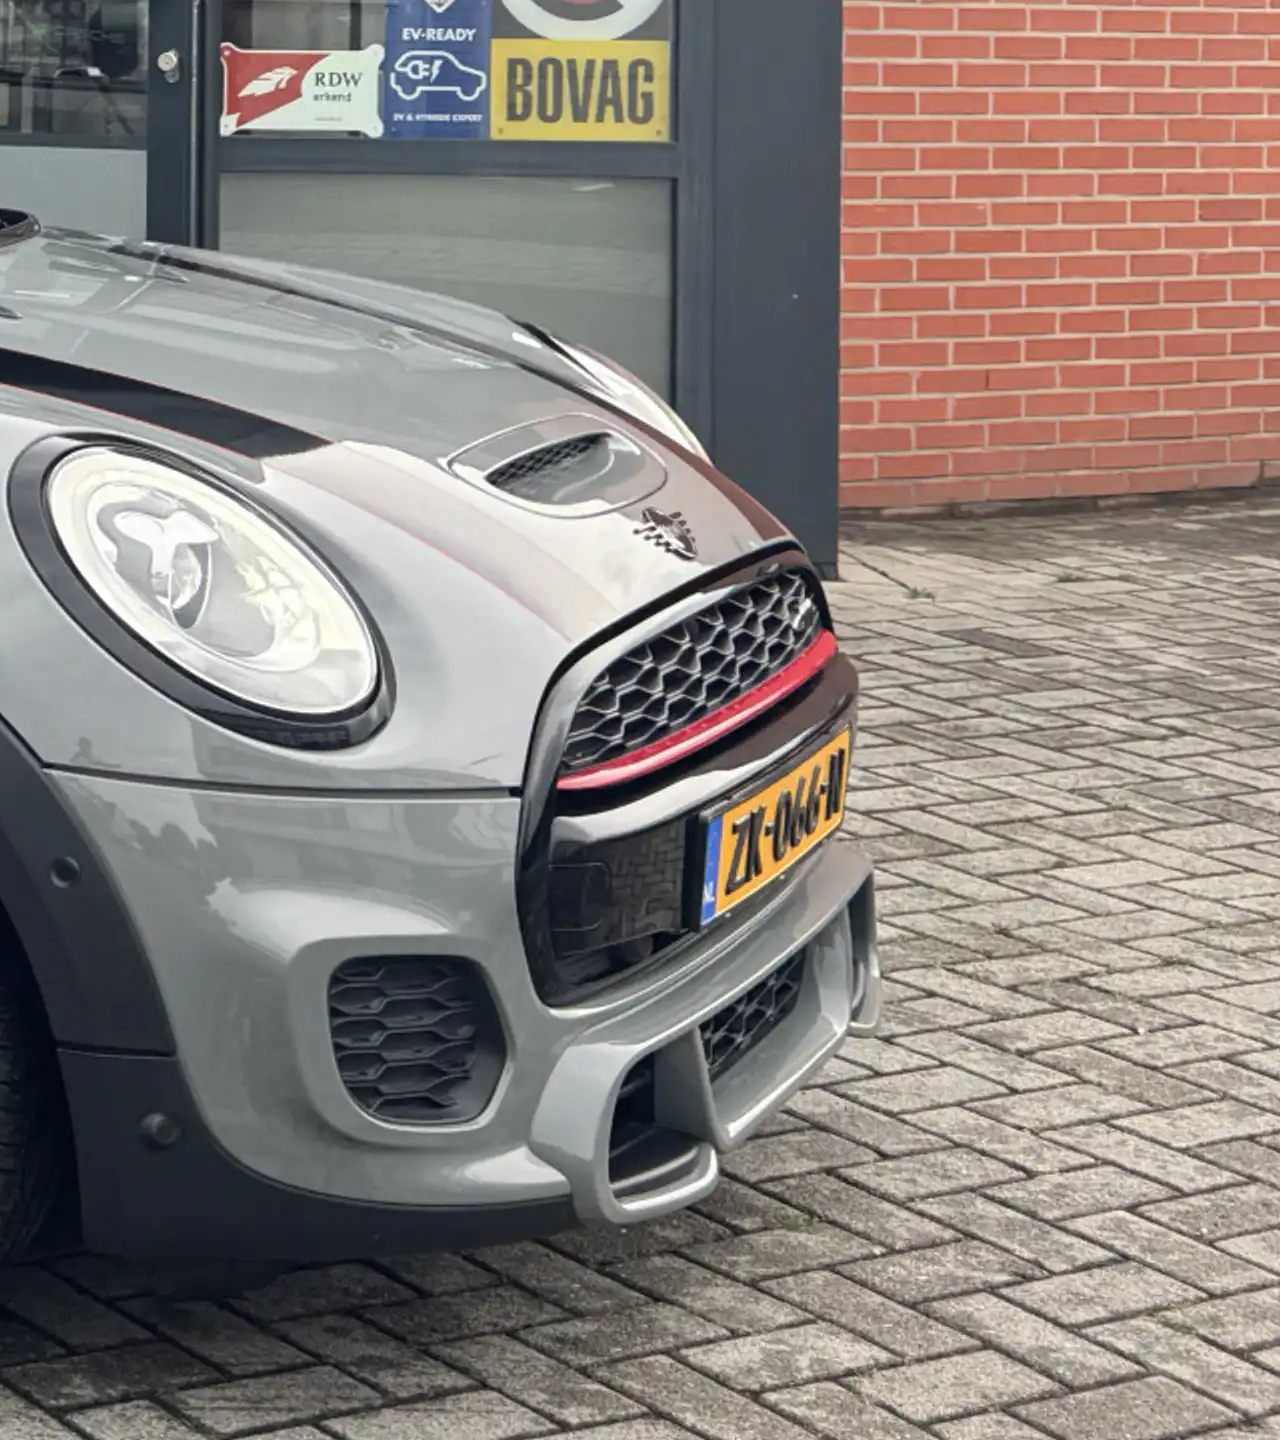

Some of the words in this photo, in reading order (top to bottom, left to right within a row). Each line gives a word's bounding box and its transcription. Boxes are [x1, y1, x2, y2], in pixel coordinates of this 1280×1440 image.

[402, 27, 477, 42] EV-READY
[314, 71, 364, 88] RDW
[506, 56, 656, 125] BOVAG
[725, 748, 846, 895] ZK-066-N
